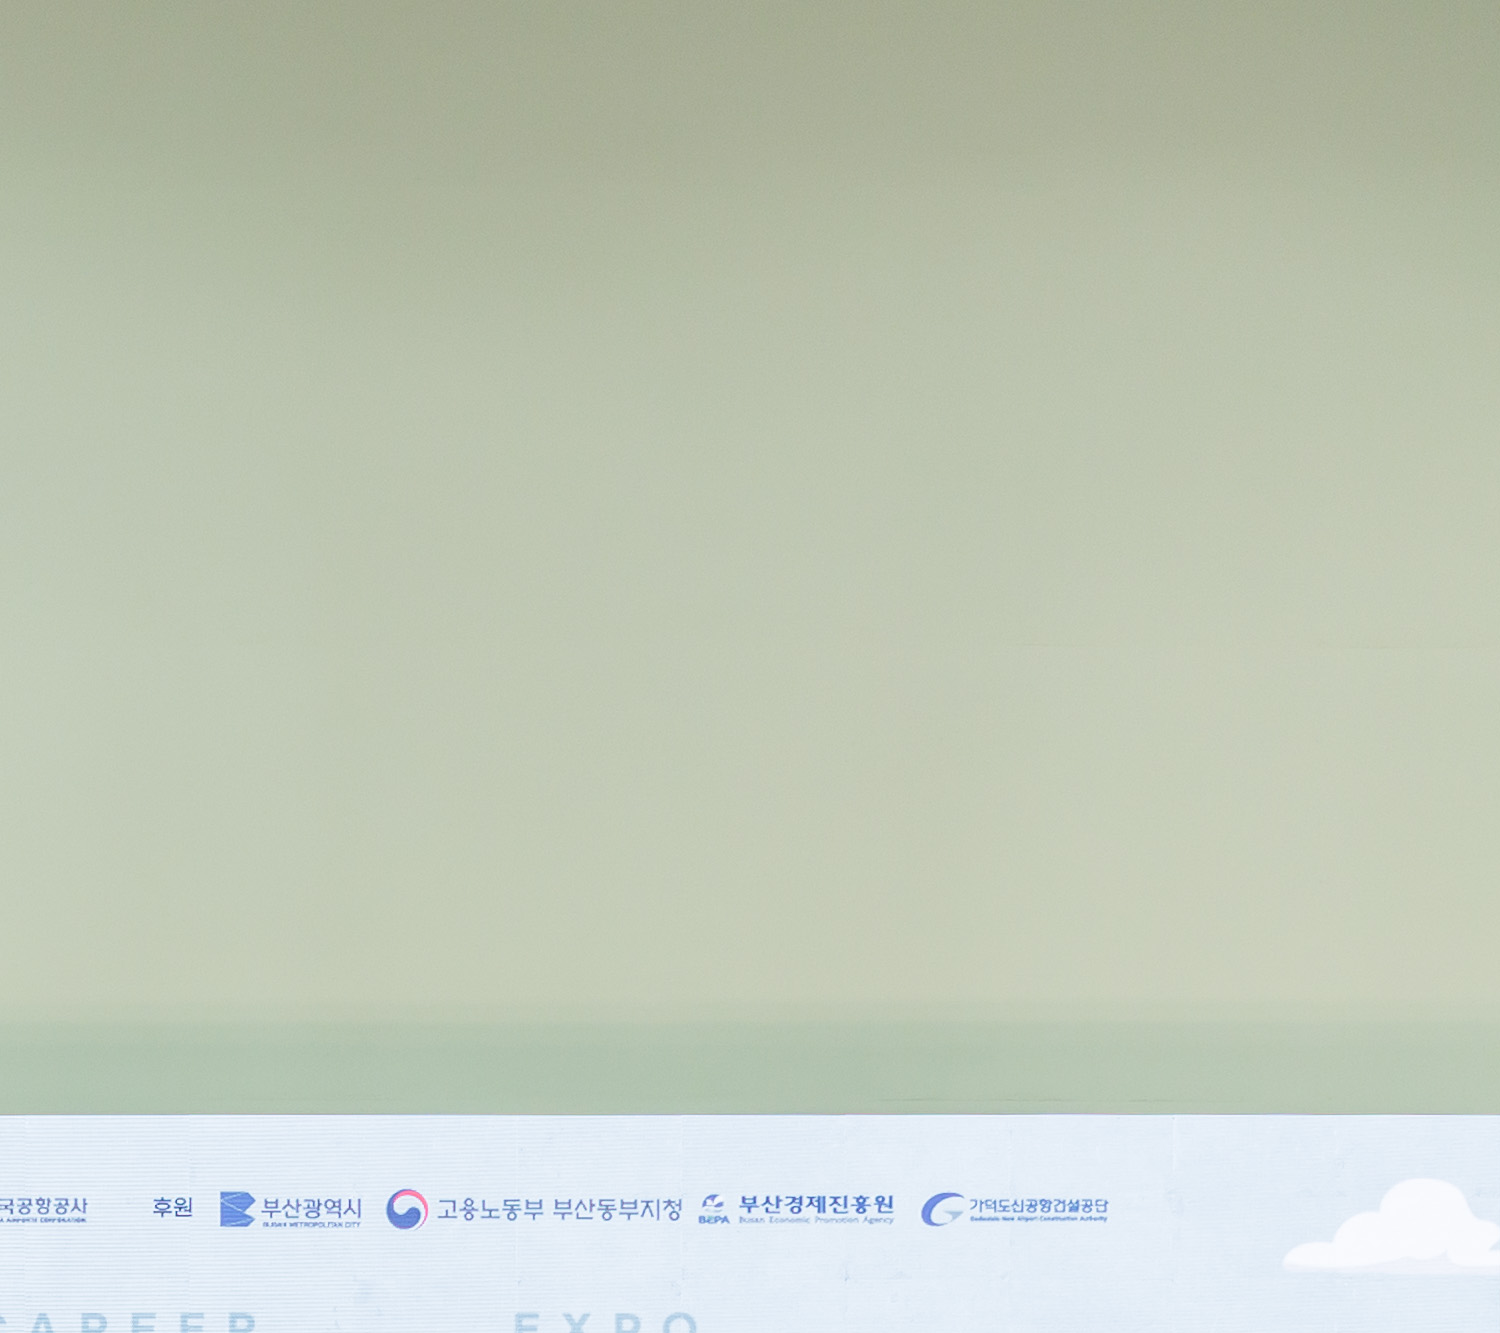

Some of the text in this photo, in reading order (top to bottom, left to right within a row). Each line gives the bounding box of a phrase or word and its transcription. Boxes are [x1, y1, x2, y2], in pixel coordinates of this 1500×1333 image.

[153, 1197, 193, 1218] 후원
[261, 1198, 361, 1219] 부산광역시
[437, 1198, 683, 1221] 고용노동부 부산동부지청
[739, 1195, 894, 1214] 부산경제진흥원
